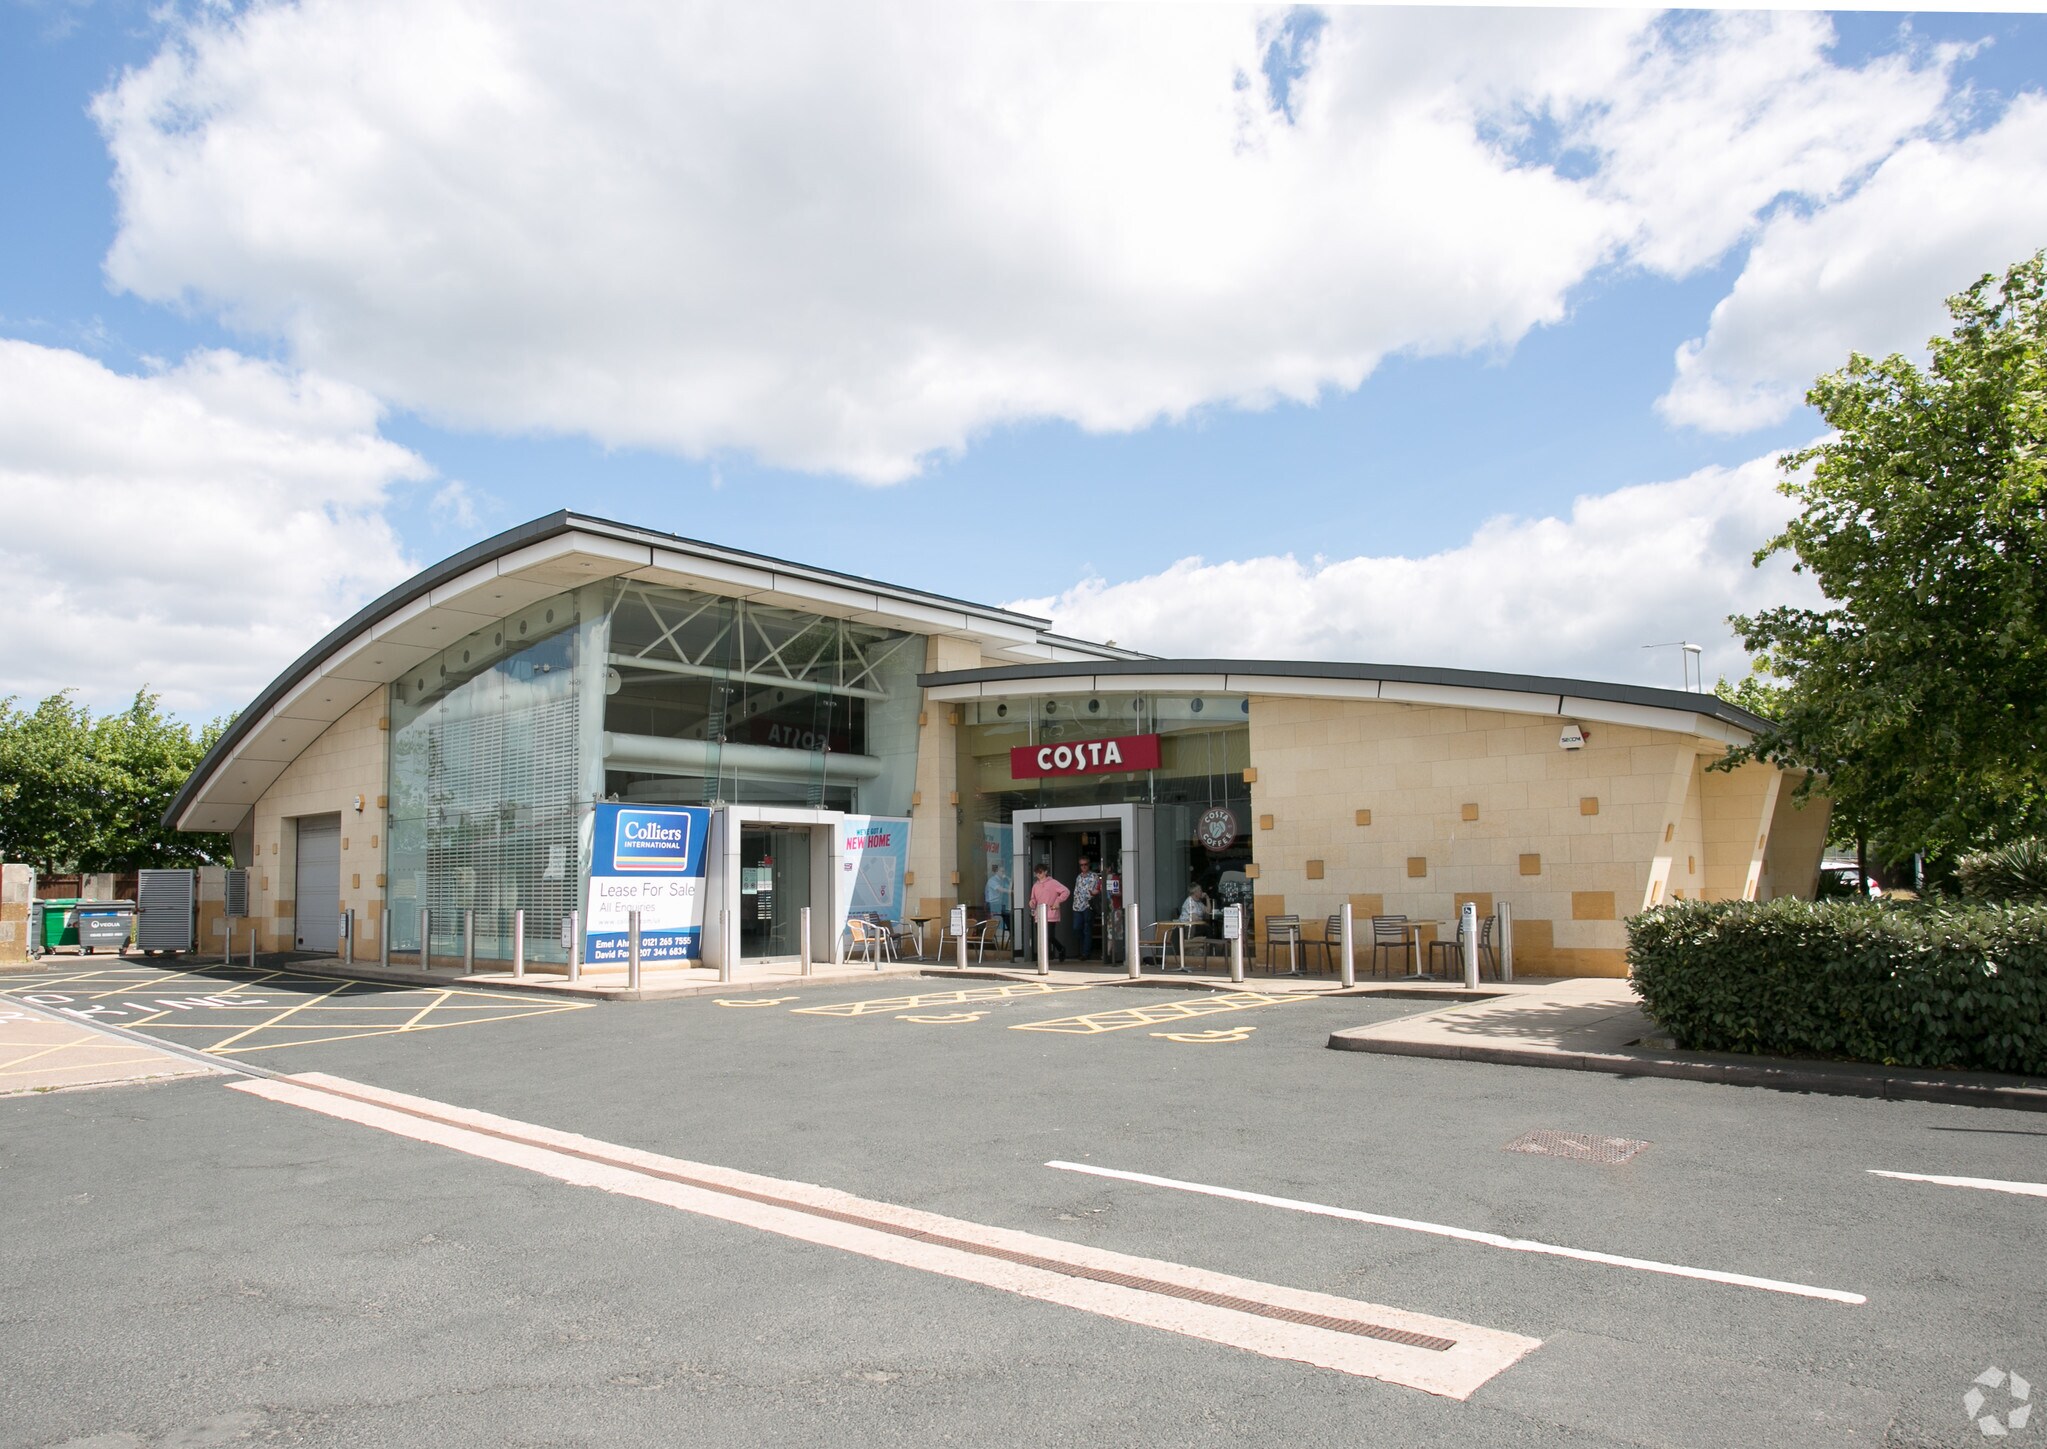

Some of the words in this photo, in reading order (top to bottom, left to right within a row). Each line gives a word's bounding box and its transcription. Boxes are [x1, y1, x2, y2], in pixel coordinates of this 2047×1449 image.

[1037, 741, 1123, 771] COSTA
[1204, 810, 1229, 823] COSTA
[624, 821, 682, 841] Colliers
[624, 841, 680, 849] INTERNATIONAL
[846, 836, 866, 850] NEW
[867, 834, 891, 848] HOME
[1203, 832, 1232, 847] COFFEE
[600, 882, 638, 897] Lease
[643, 882, 663, 897] For
[669, 882, 696, 897] Sale
[599, 902, 612, 912] All
[615, 902, 656, 912] Enquiries
[595, 940, 614, 949] Emel
[642, 938, 657, 947] 0121
[659, 937, 672, 946] 265
[674, 936, 691, 945] 7555
[595, 950, 615, 960] David
[653, 948, 667, 956] 344
[669, 947, 687, 956] 6834
